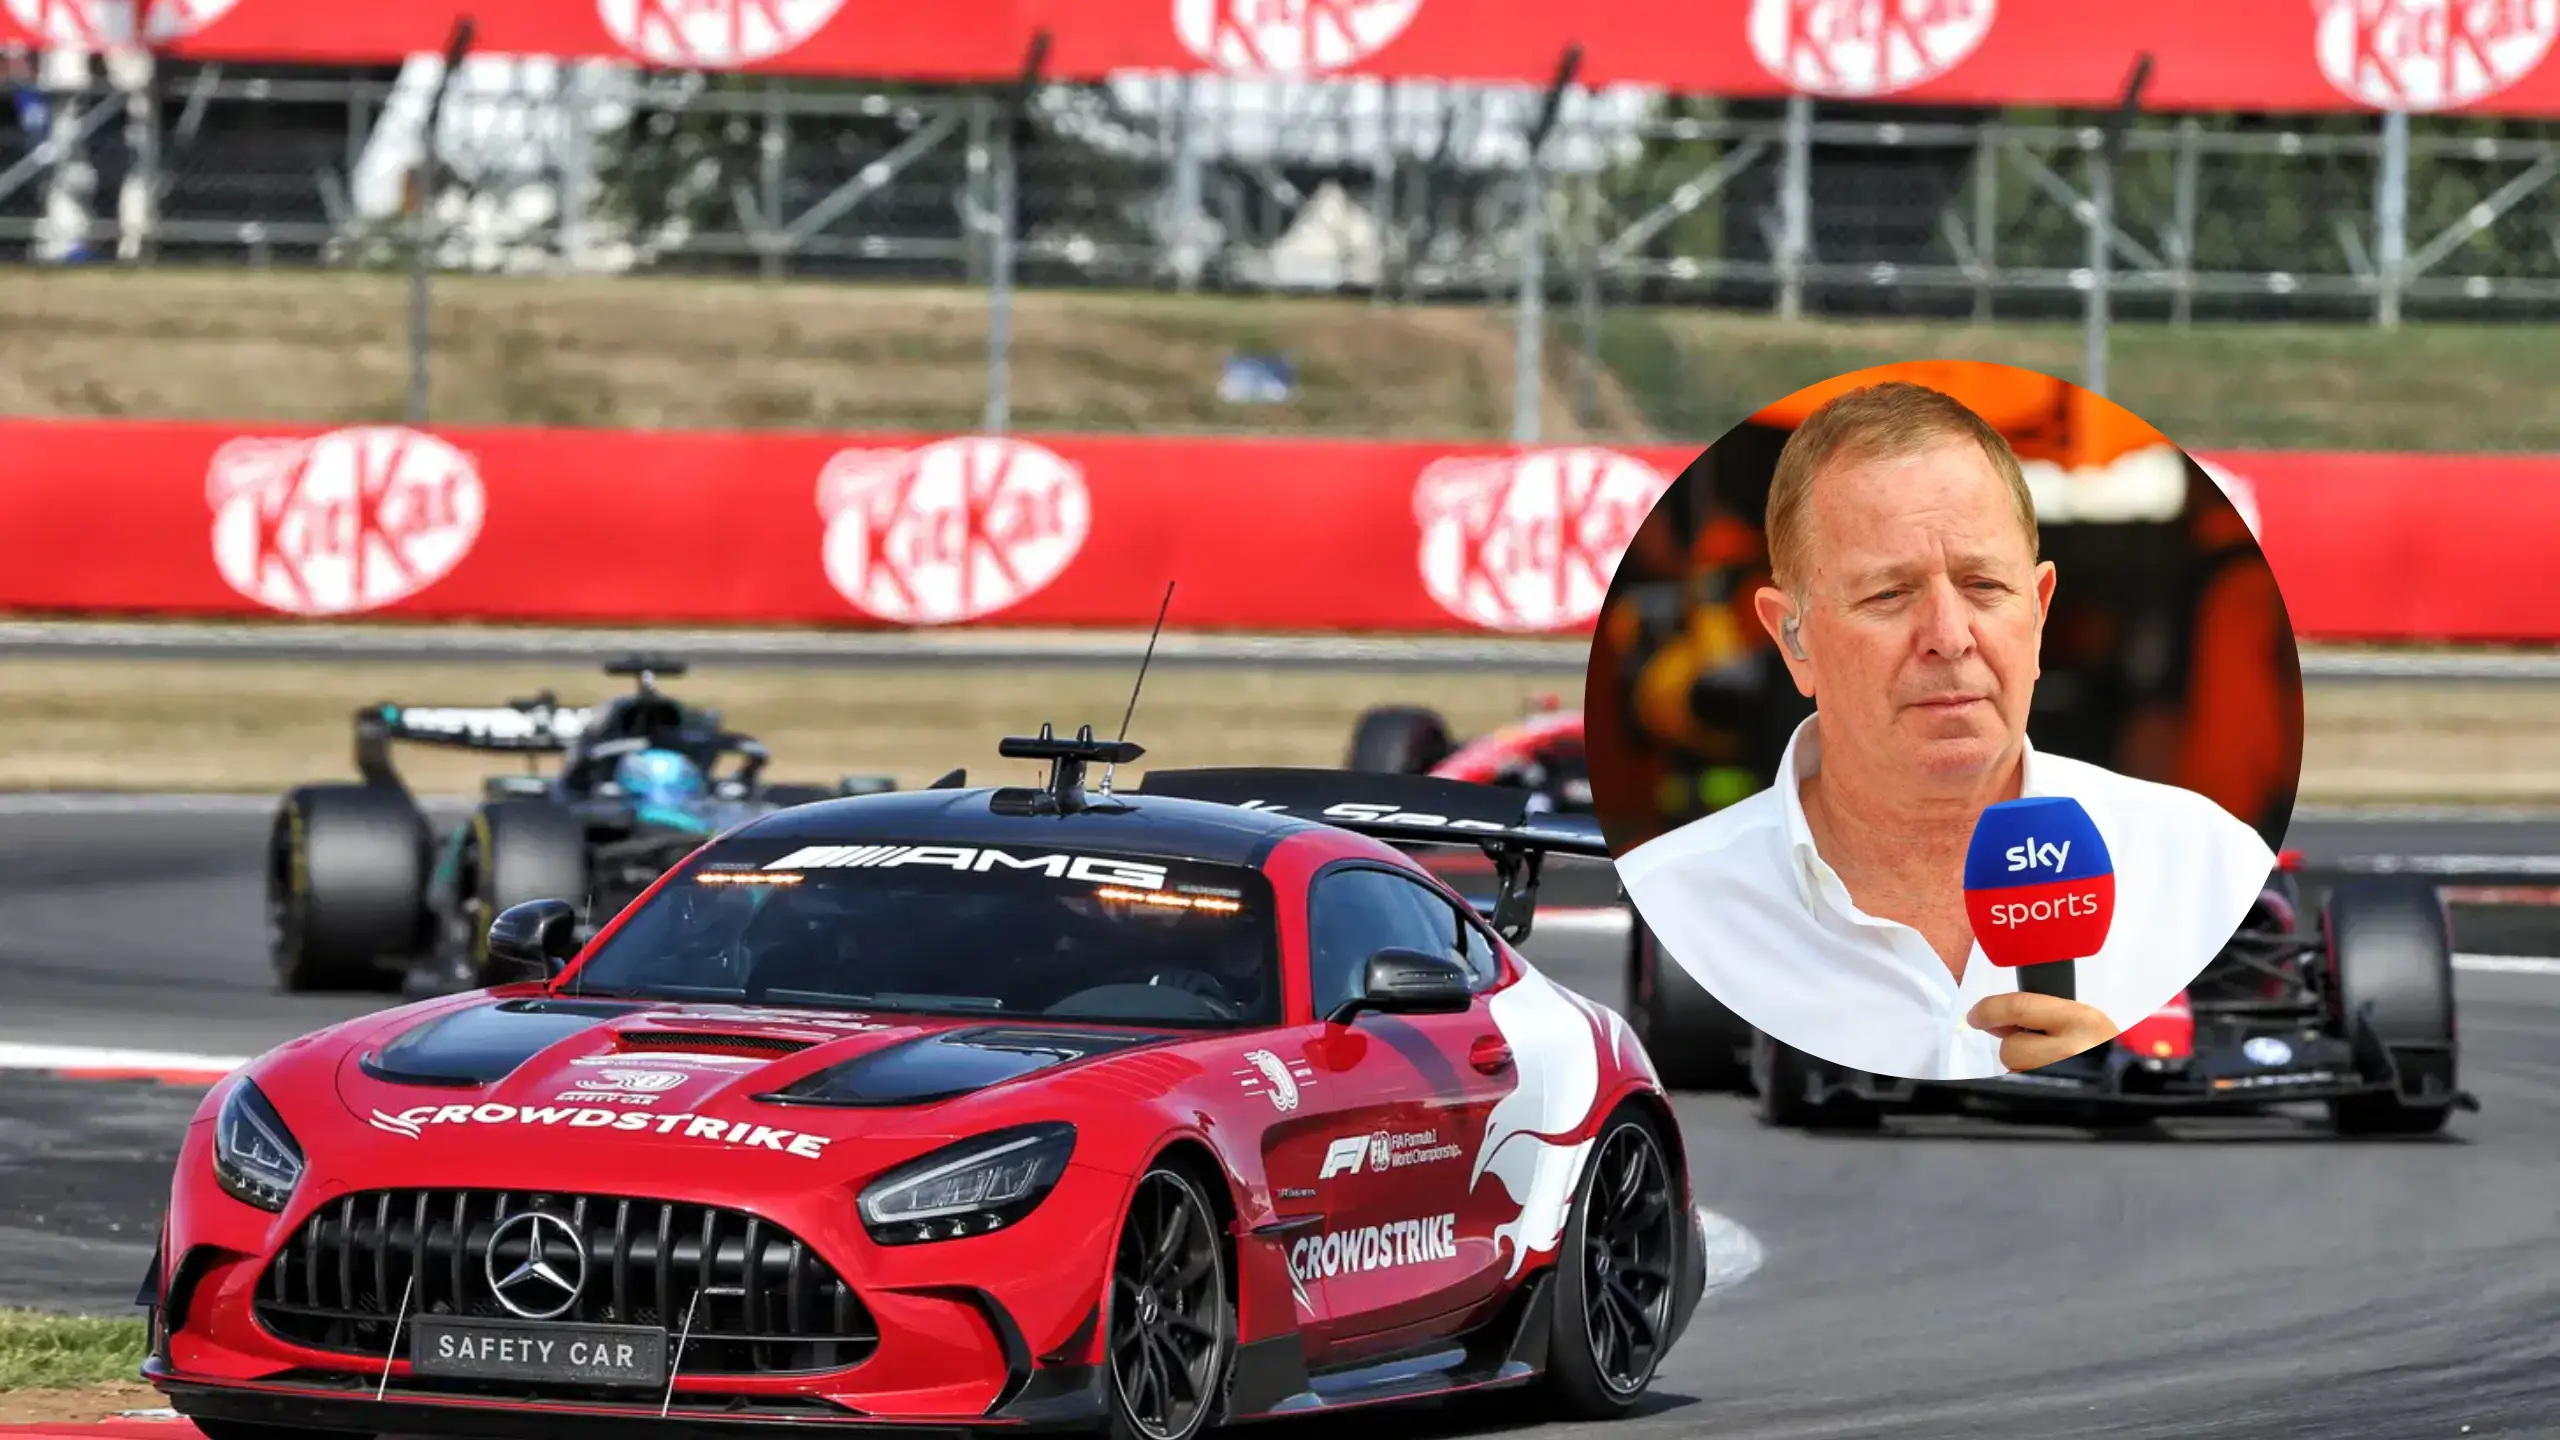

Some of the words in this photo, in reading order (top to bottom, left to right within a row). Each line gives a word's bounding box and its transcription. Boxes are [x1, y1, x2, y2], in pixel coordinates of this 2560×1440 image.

[892, 846, 1168, 890] AMG
[2005, 837, 2071, 873] sky
[1991, 893, 2098, 930] sports
[397, 1103, 831, 1159] CROWDSTRIKE
[1319, 1135, 1371, 1179] F1
[1292, 1213, 1457, 1281] CROWDSTRIKE
[438, 1334, 554, 1363] SAFETY
[570, 1341, 634, 1368] CAR
